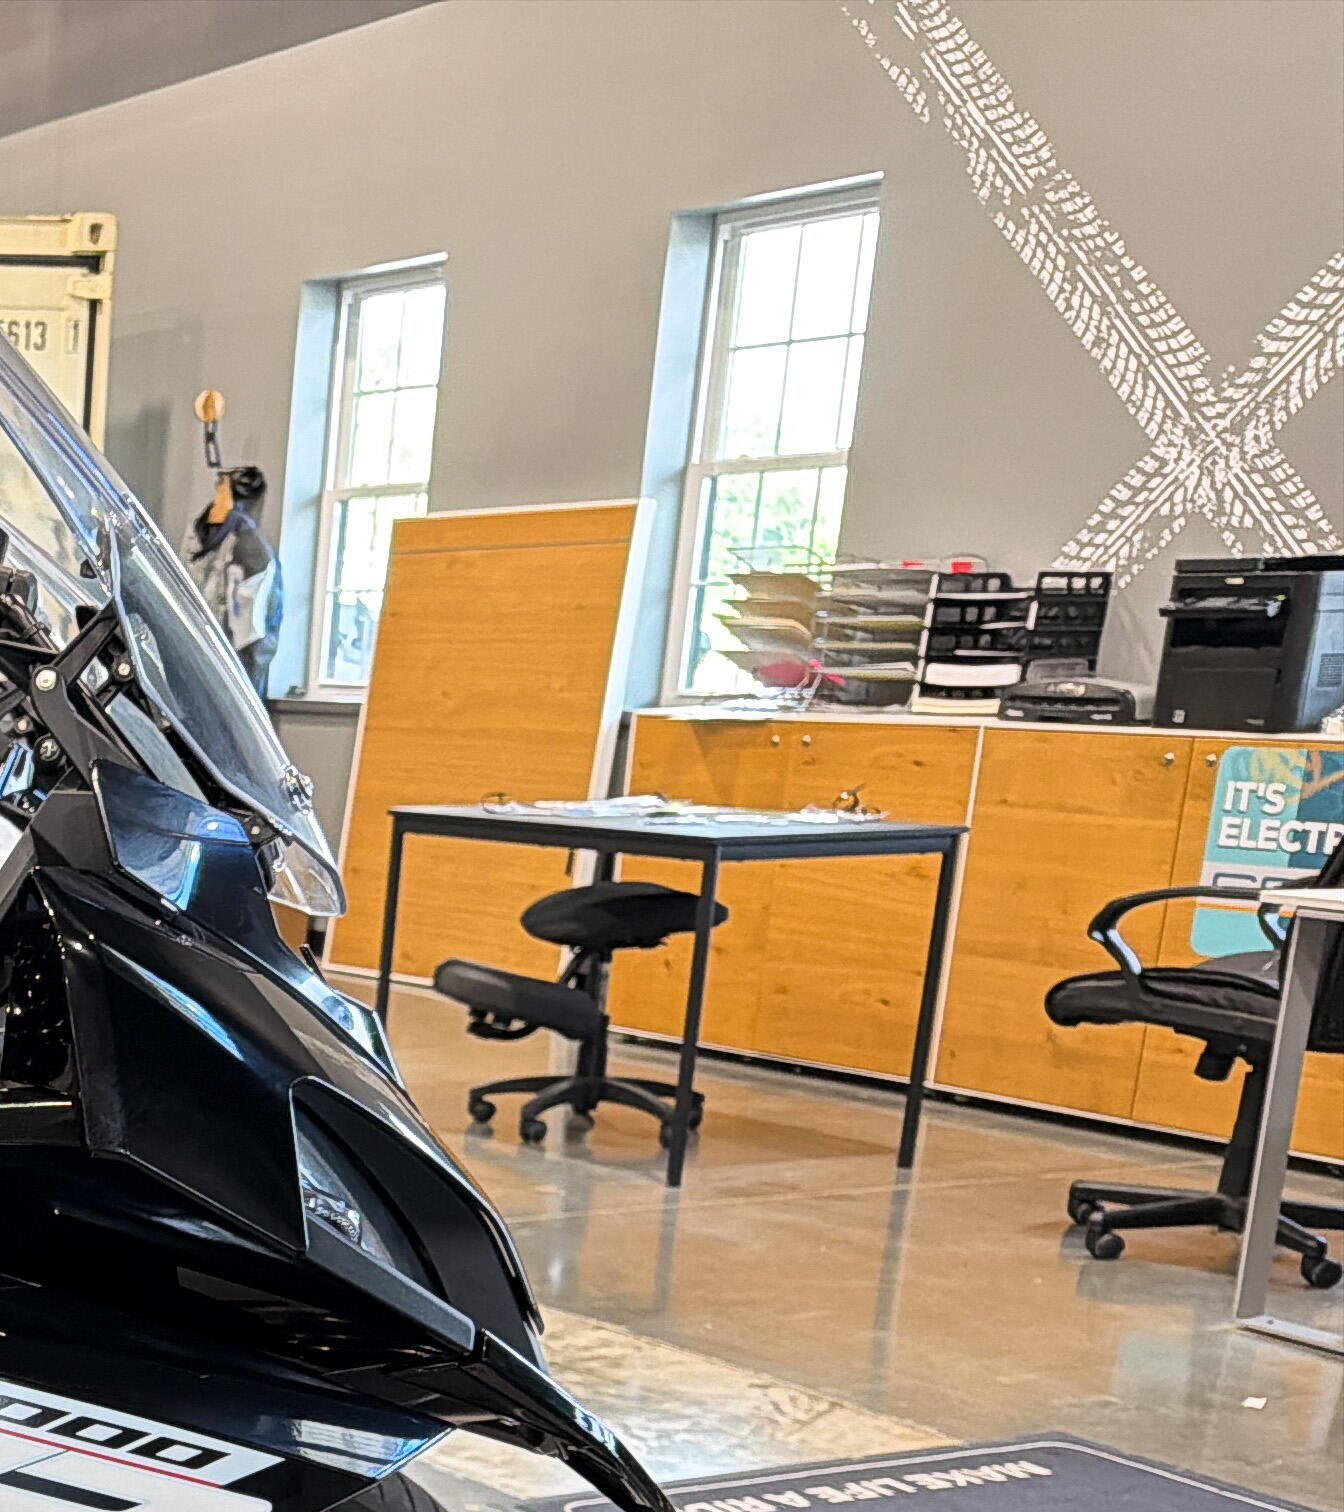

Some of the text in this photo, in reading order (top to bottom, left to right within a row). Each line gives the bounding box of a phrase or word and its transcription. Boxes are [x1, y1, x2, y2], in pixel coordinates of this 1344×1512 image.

[1223, 780, 1287, 815] IT'S
[904, 1460, 1053, 1491] MAKE
[761, 1490, 811, 1508] A
[805, 1477, 917, 1503] LIFE
